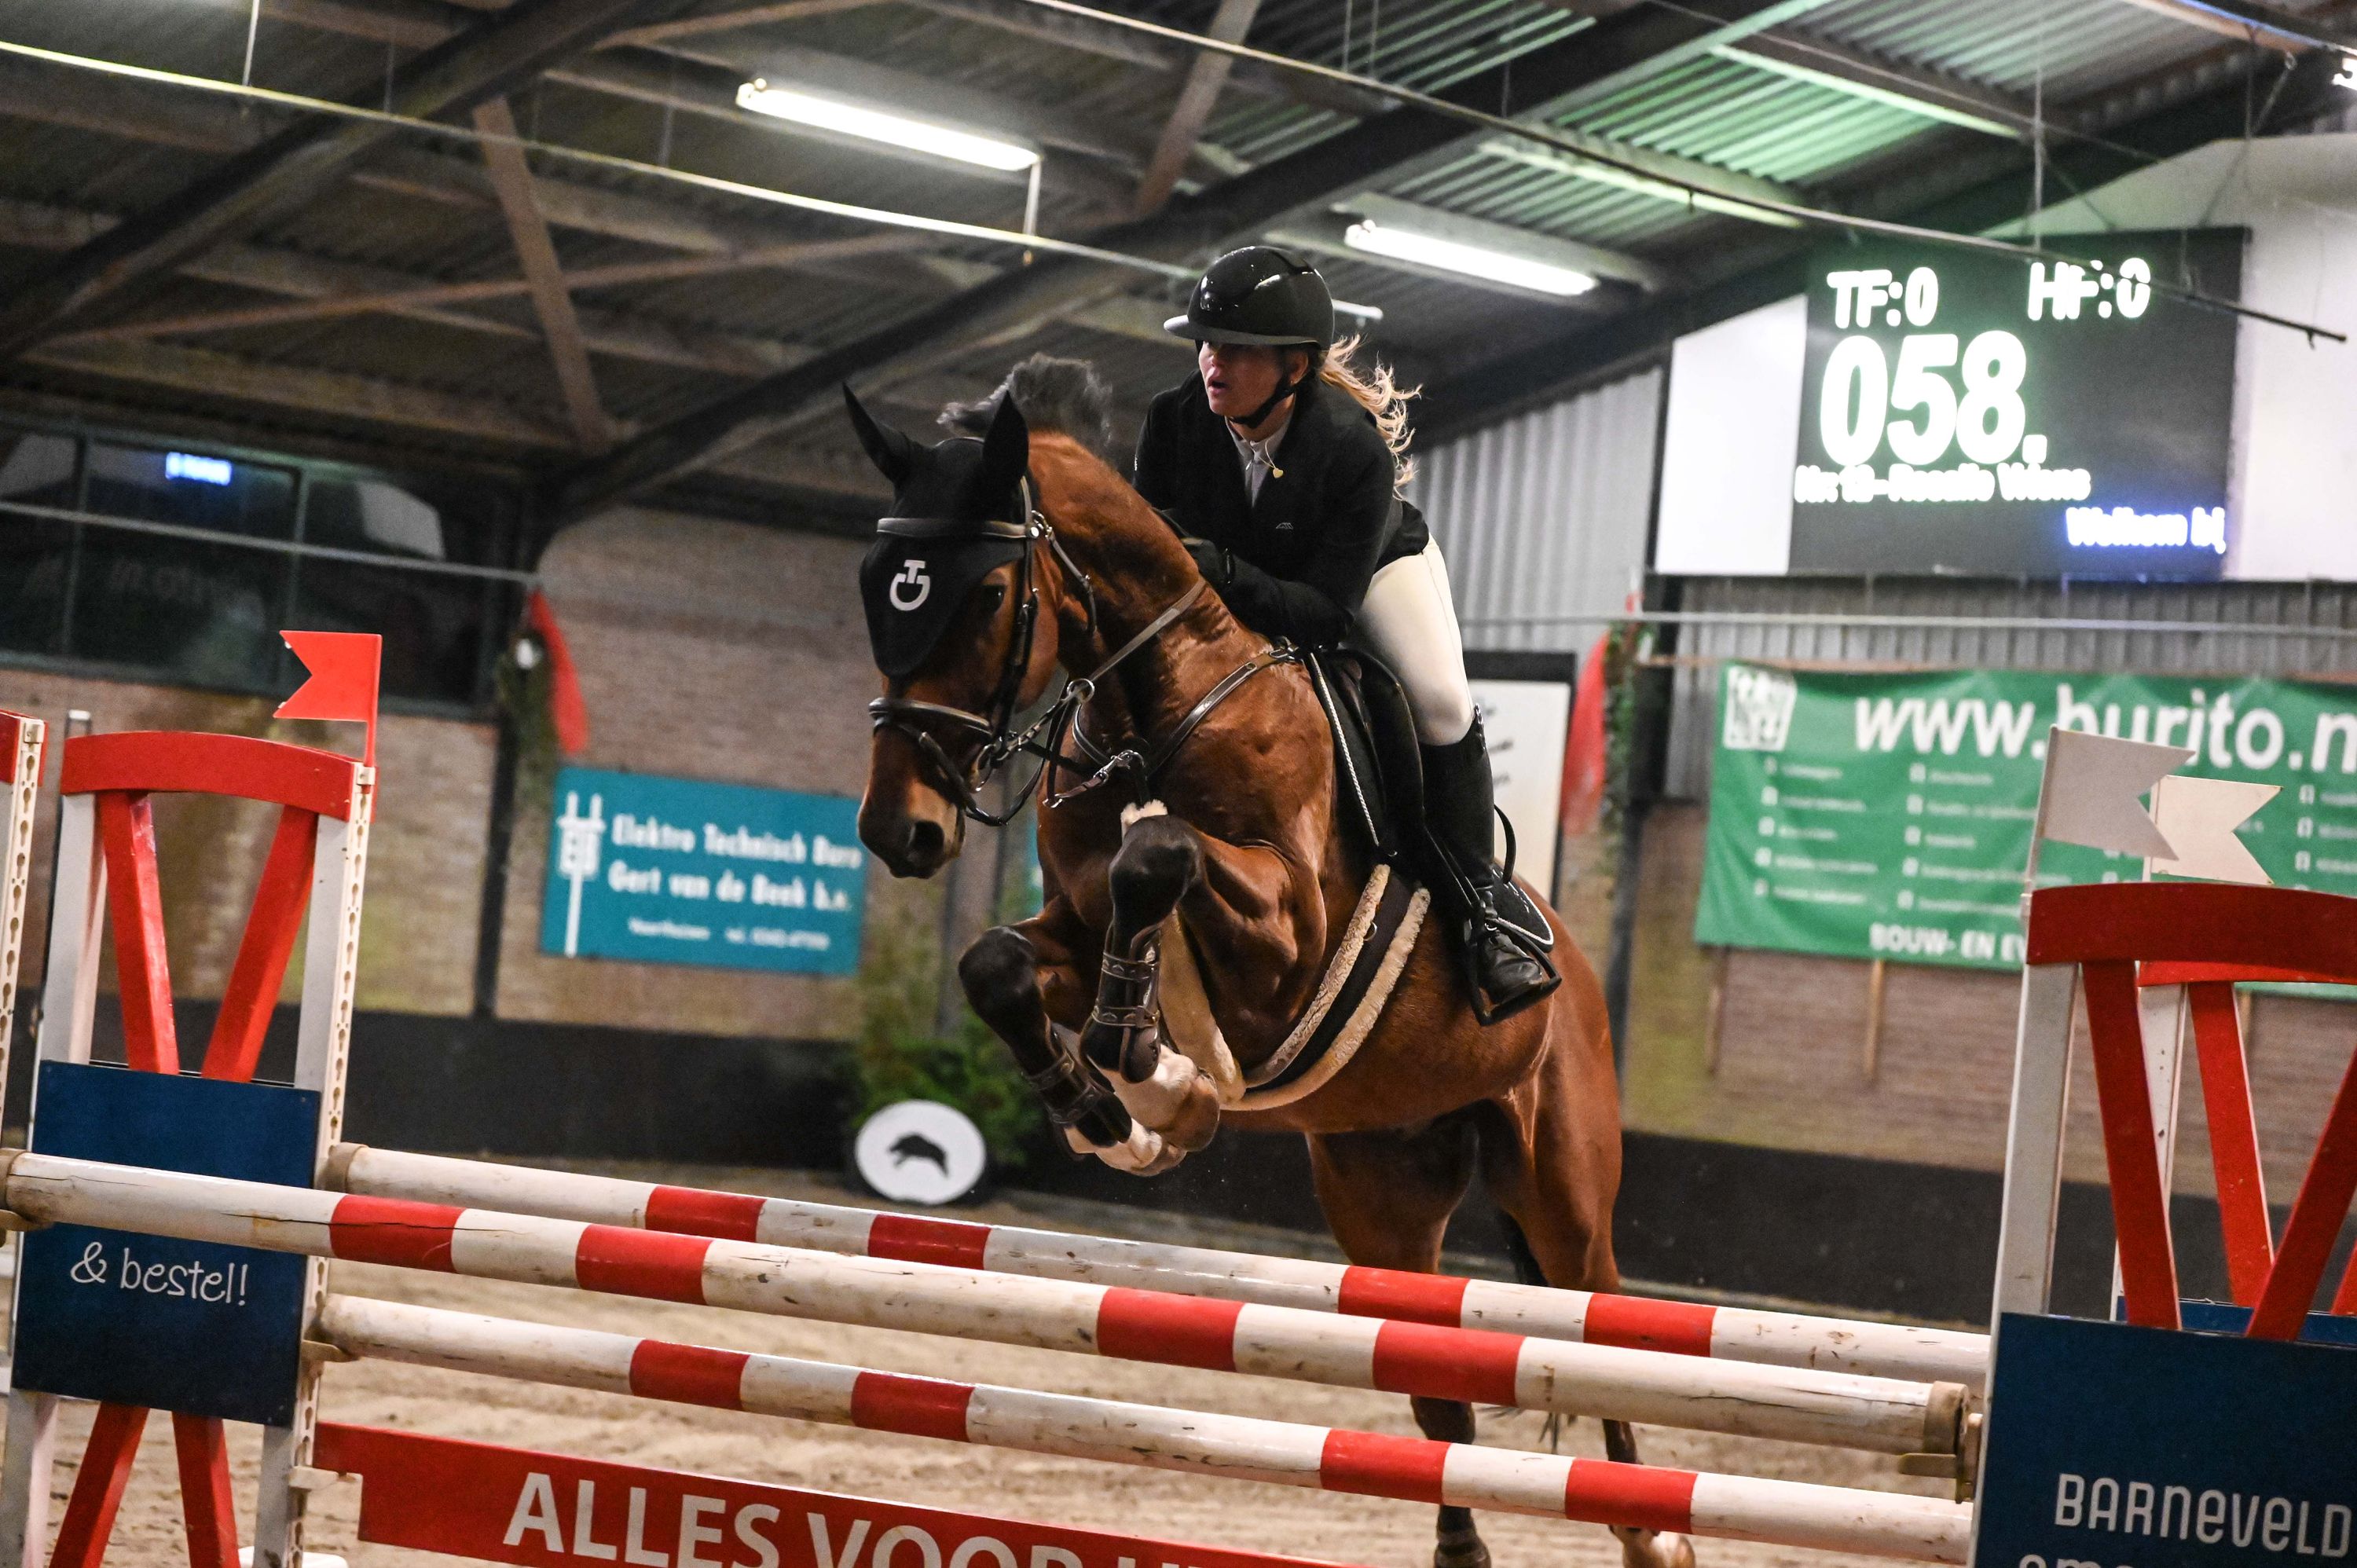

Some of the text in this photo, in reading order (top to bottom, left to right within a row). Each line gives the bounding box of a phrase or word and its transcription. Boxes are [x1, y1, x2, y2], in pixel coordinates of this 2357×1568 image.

[1827, 266, 1939, 328] TF:0
[2027, 258, 2151, 321] HF:0
[70, 1241, 248, 1306] & bestel!
[503, 1471, 781, 1568] ALLES
